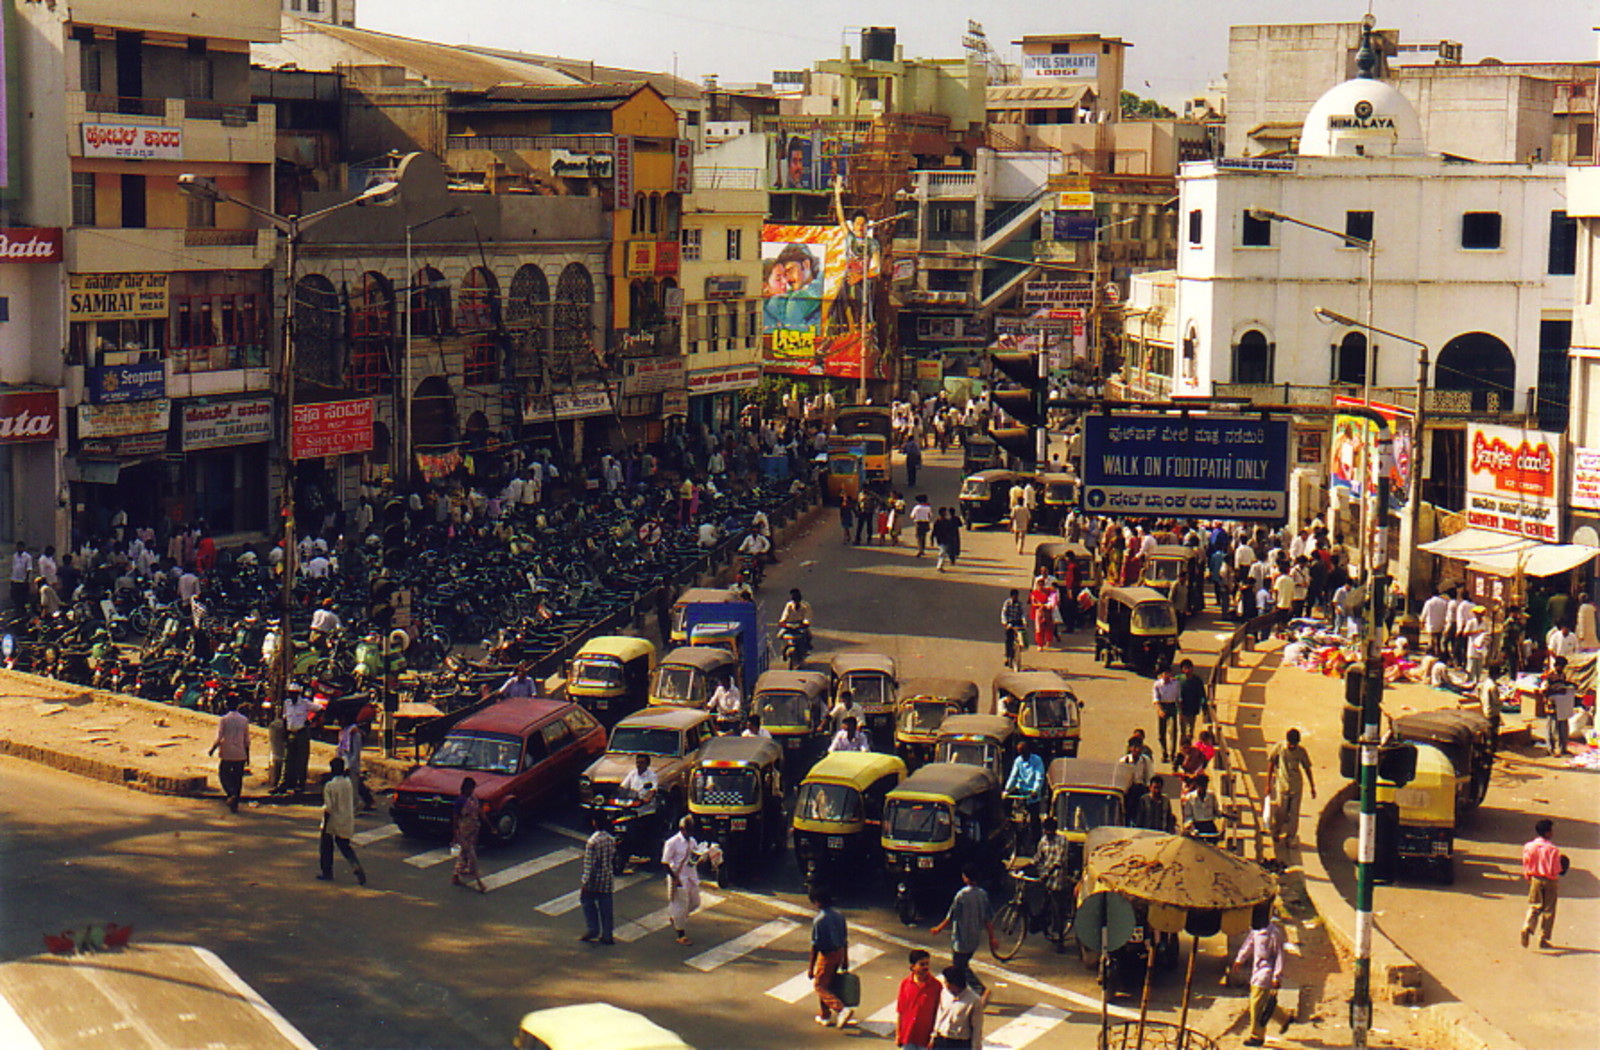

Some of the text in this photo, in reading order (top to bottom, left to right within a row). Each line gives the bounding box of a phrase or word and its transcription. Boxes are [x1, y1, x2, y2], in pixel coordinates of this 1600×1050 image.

[1024, 56, 1096, 69] HOTEL SUMANTH
[1036, 68, 1079, 76] LODGE
[1330, 118, 1396, 129] HIMALAYA
[677, 144, 689, 190] BAR
[70, 292, 135, 312] SAMRAT
[185, 428, 218, 440] HOTEL
[1103, 455, 1268, 480] WALK ON FOOTPATH ONLY
[1516, 449, 1551, 472] doodle
[1501, 518, 1523, 532] JUICE
[1524, 522, 1556, 540] CENTRE
